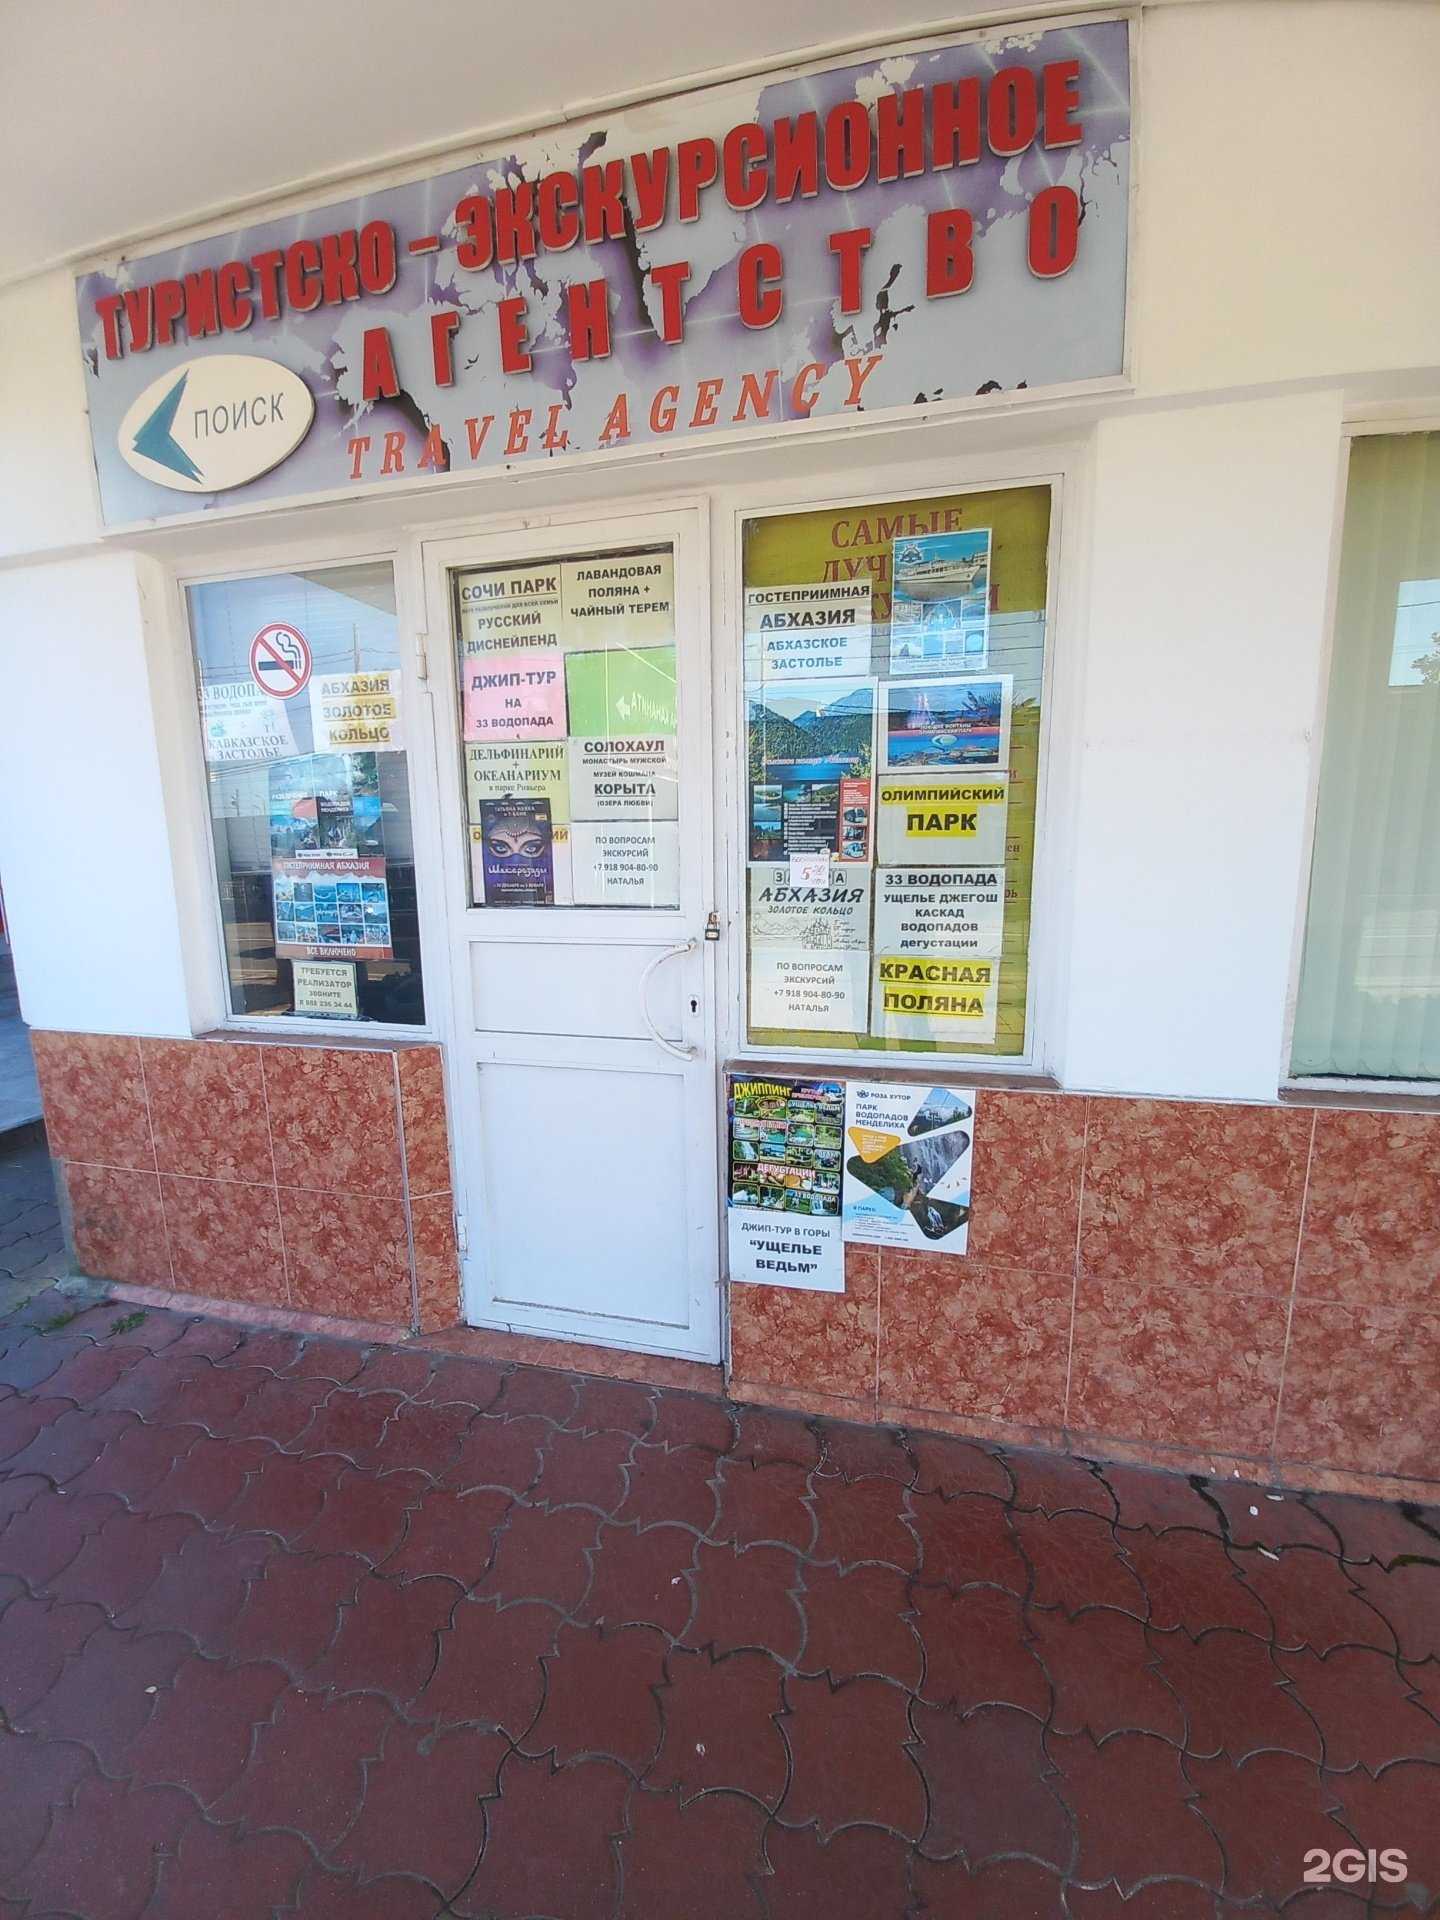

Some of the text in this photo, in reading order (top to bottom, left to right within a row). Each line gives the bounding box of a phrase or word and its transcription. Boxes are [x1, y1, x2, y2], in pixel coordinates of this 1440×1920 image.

[96, 219, 398, 361] ТУРИСТСКО
[454, 59, 1083, 273] ЭКСКУРСИОННОЕ
[361, 184, 1080, 402] АГЕНТСТВО
[193, 391, 287, 441] ПОИСК
[346, 354, 884, 481] TRAVEL AGENCY
[831, 507, 963, 549] САМЫЕ
[576, 565, 662, 581] ЛАВАНДОВАЯ
[462, 577, 557, 600] СОЧИ ПАРК
[588, 586, 640, 598] ПОЛЯНА
[748, 585, 870, 603] ГОСТЕПРИИМНАЯ
[570, 601, 670, 617] ЧАЙНЫЙ ТЕРЕМ
[478, 610, 541, 630] РУССКИЙ
[760, 608, 856, 629] АБХАЗИЯ
[467, 633, 558, 653] ДИСНЕЙЛЕНД
[767, 637, 848, 651] АБХАЗСКОЕ
[771, 656, 843, 670] ЗАСТОЛЬЕ
[321, 678, 390, 695] АБХАЗИЯ
[471, 671, 557, 690] ДЖИП-ТУР
[505, 698, 522, 709] НА
[322, 703, 392, 719] ЗОЛОТОЕ
[476, 716, 554, 729] 33 ВОДОПАДА
[329, 726, 390, 742] КОЛЬЦО
[584, 740, 665, 753] СОЛОХАУЛ
[217, 747, 281, 760] ЗАСТОЛЬЕ
[469, 746, 564, 761] ДЕЛЬФИНАРИЙ
[582, 756, 667, 765] МОНАСТЫРЬ МУЖСКОЙ
[473, 769, 561, 782] ОКЕАНАРИУМ
[593, 770, 617, 778] МУЗЕЙ
[494, 784, 515, 793] парке
[516, 783, 546, 792] Ривьера
[594, 783, 656, 795] КОРЫТА
[881, 786, 1005, 802] ОЛИМПИЙСКИЙ
[597, 799, 622, 807] (ОЗЕРА
[907, 812, 978, 831] ПАРК
[595, 836, 656, 845] ПО ВОПРОСАМ
[602, 848, 649, 858] ЭКСКУРСИЙ
[336, 861, 370, 871] АБХАЗИЯ
[604, 864, 618, 872] 918
[607, 877, 645, 885] НАТАЛЬЯ
[885, 873, 998, 886] 33 ВОДОПАДА
[758, 886, 865, 903] АБХАЗИЯ
[883, 893, 935, 905] УЩЕЛЬЕ
[938, 893, 998, 905] ДЖЕГОШ
[768, 905, 853, 915] ЗОЛОТОЕ КОЛЬЦО
[915, 908, 965, 919] КАСКАД
[900, 922, 979, 933] ВОДОПАДОВ
[900, 938, 978, 949] дегустации
[301, 967, 348, 977] ТРЕБУЕТСЯ
[776, 963, 843, 973] ПО ВОПРОСАМ
[879, 963, 991, 984] КРАСНАЯ
[297, 978, 353, 988] РЕАЛИЗАТОР
[783, 974, 835, 985] ЭКСКУРСИЙ
[773, 990, 845, 1000] +7 918 904-80-90
[788, 1003, 830, 1013] НАТАЛЬЯ
[883, 993, 984, 1014] ПОЛЯНА
[733, 1082, 793, 1099] ДЖИППИНГ
[855, 1103, 878, 1111] ПАРК
[855, 1111, 909, 1122] ВОДОПАДОВ
[855, 1119, 906, 1129] МЕНДЕЛИХА
[757, 1162, 816, 1179] ДЕГУСТАЦИИ
[741, 1222, 794, 1237] ДЖИП-ТУР
[803, 1228, 831, 1238] ГОРЫ
